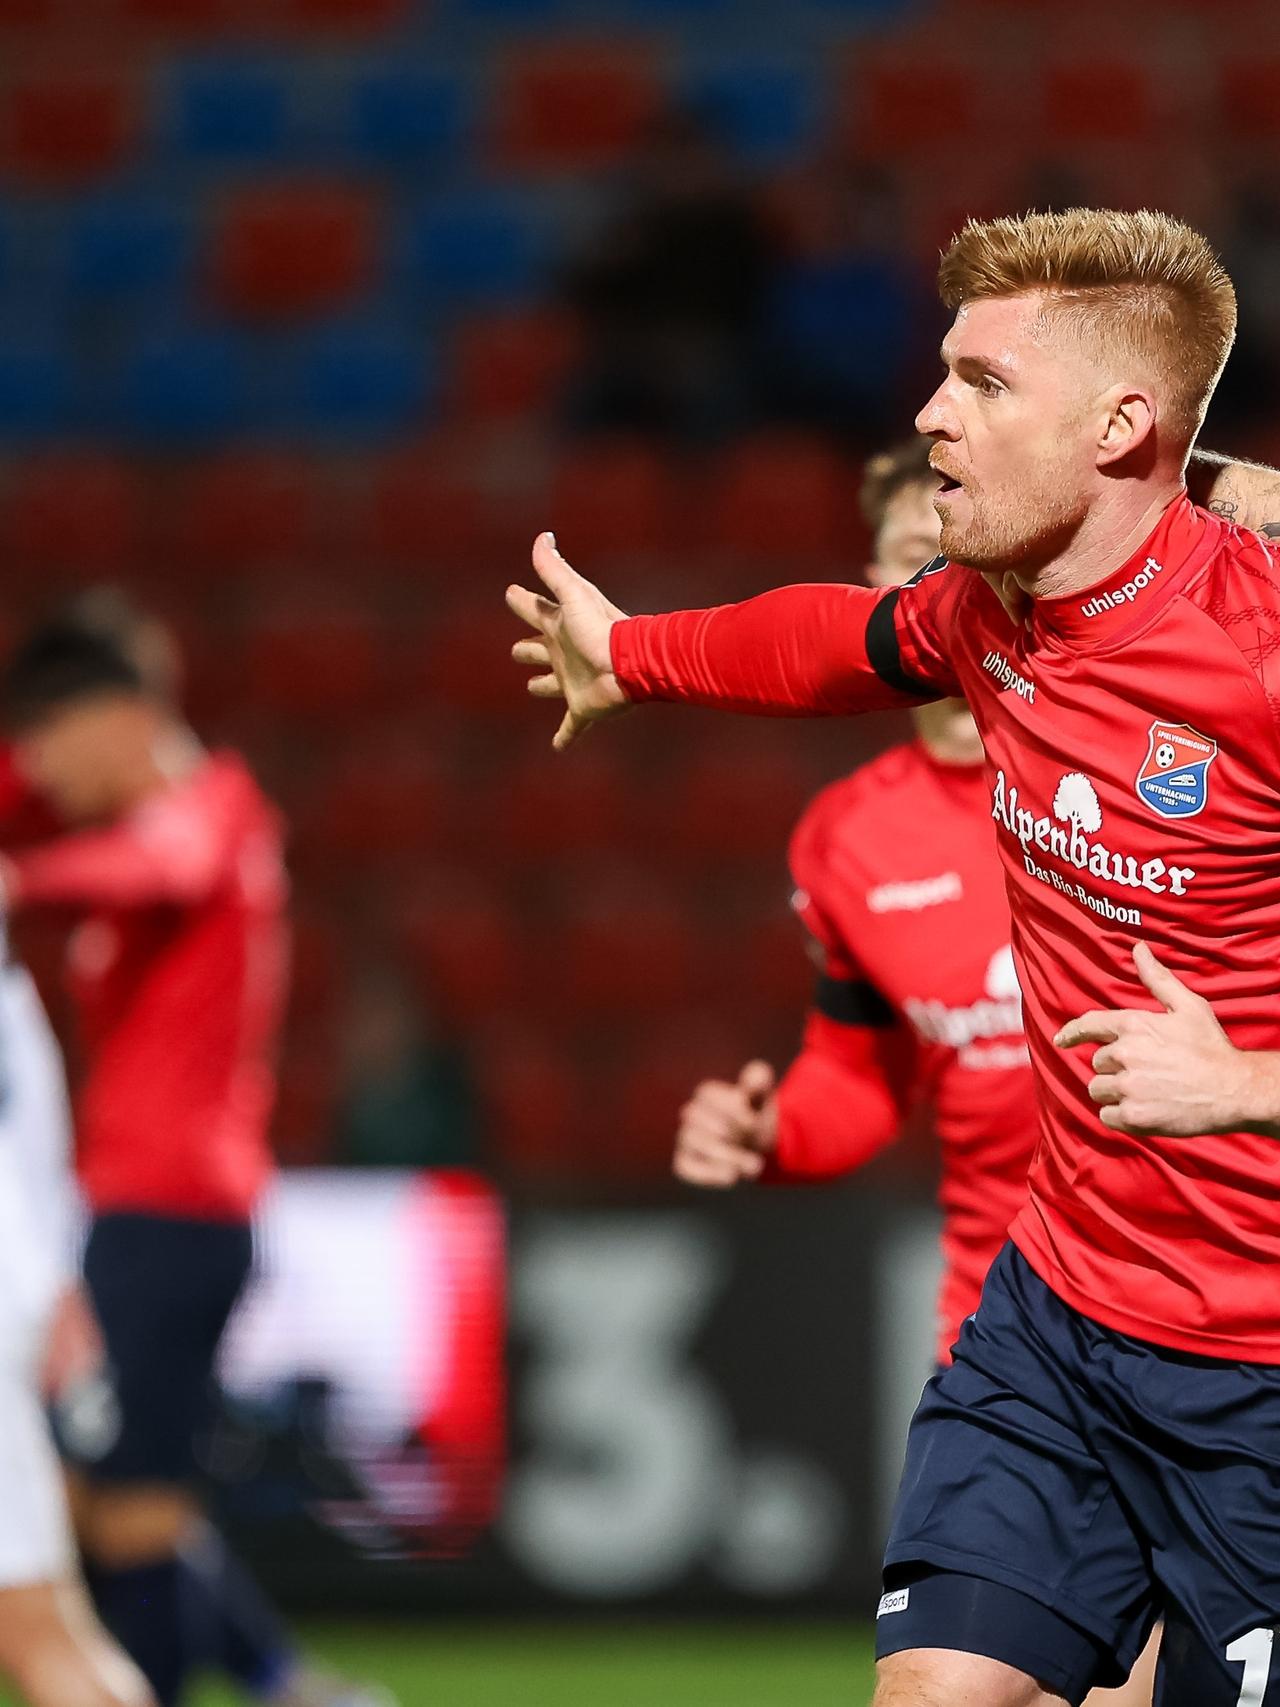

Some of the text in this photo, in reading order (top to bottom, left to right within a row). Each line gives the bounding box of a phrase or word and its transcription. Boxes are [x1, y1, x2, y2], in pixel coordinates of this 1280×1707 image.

[1081, 557, 1162, 618] uhlsport
[982, 651, 1036, 704] uhlsport
[1145, 782, 1198, 805] UNTERHACHING
[992, 770, 1196, 896] Alpenbauer
[1023, 855, 1142, 926] Das Bio-Bonbon
